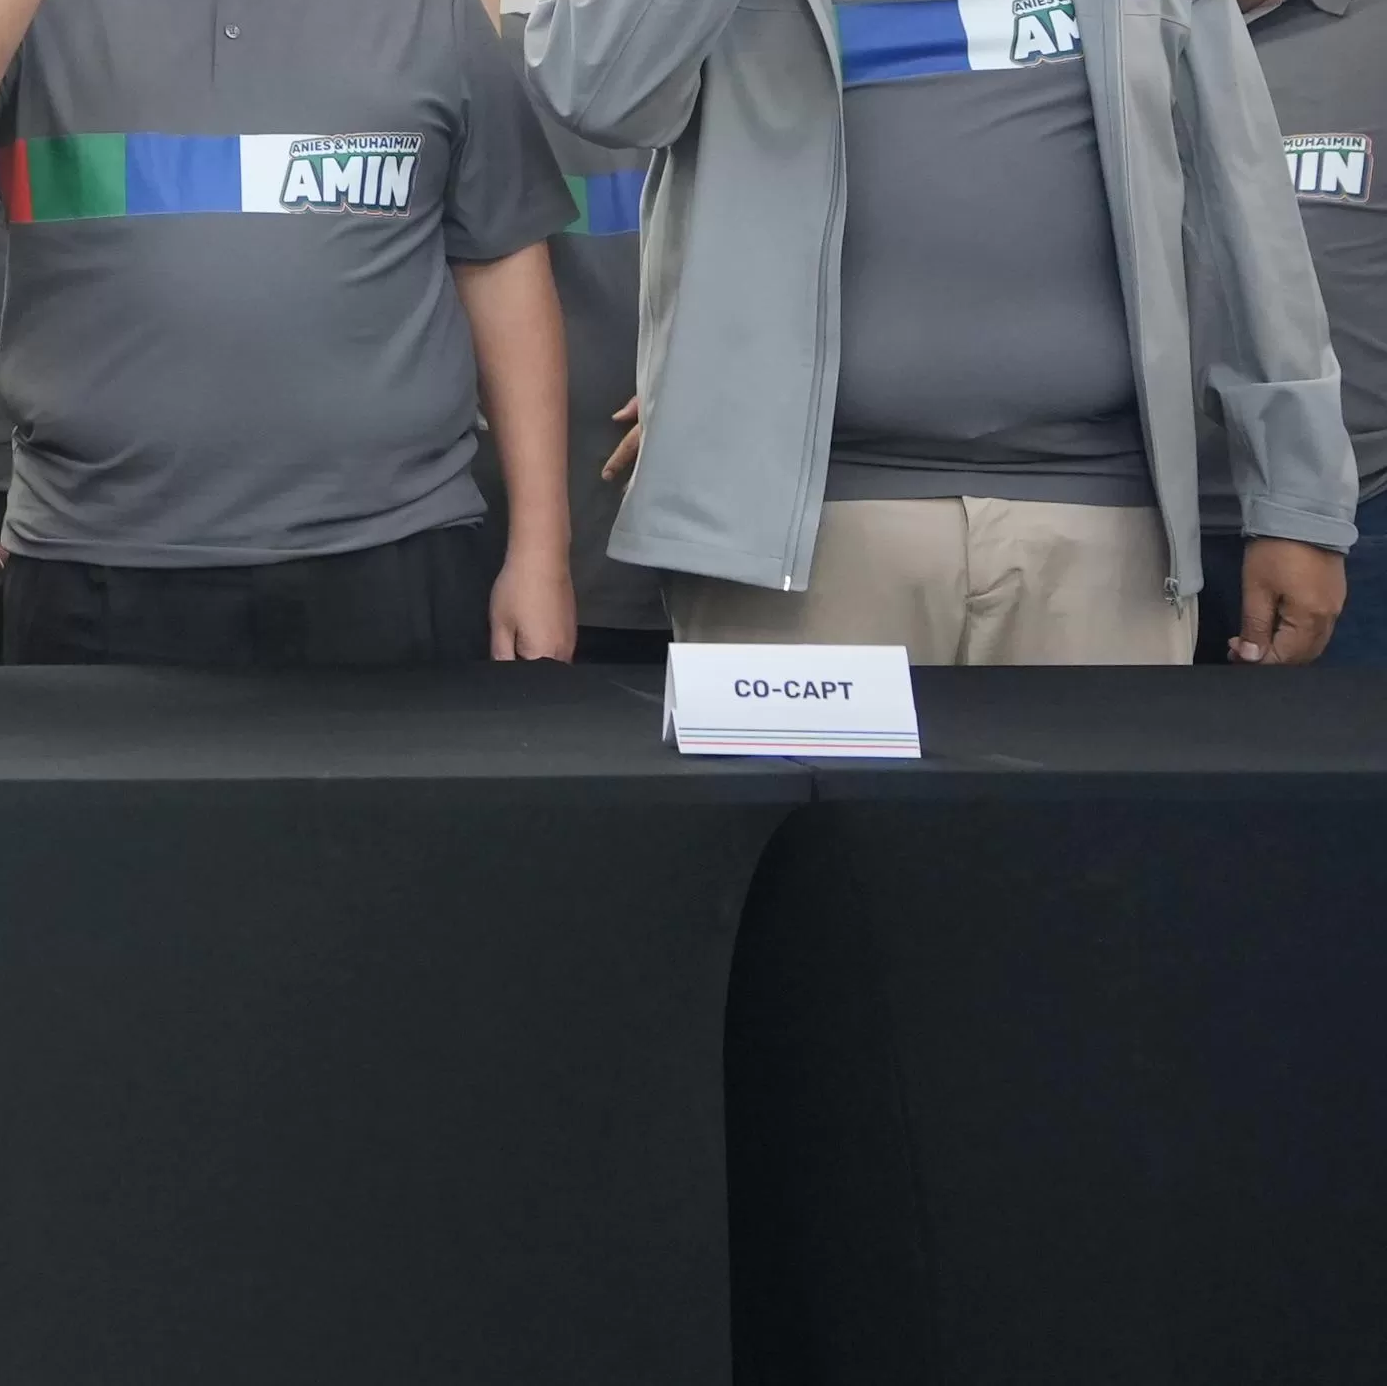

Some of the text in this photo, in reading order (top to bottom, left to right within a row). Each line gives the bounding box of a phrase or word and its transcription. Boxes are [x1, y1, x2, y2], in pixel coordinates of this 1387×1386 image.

[1014, 9, 1080, 60] AM
[292, 137, 419, 153] ANIES & MUHAIMIN
[1283, 137, 1362, 148] MUHAIMIN
[283, 155, 416, 207] AMIN
[1286, 151, 1365, 194] IN
[734, 679, 853, 700] CO-CAPT
